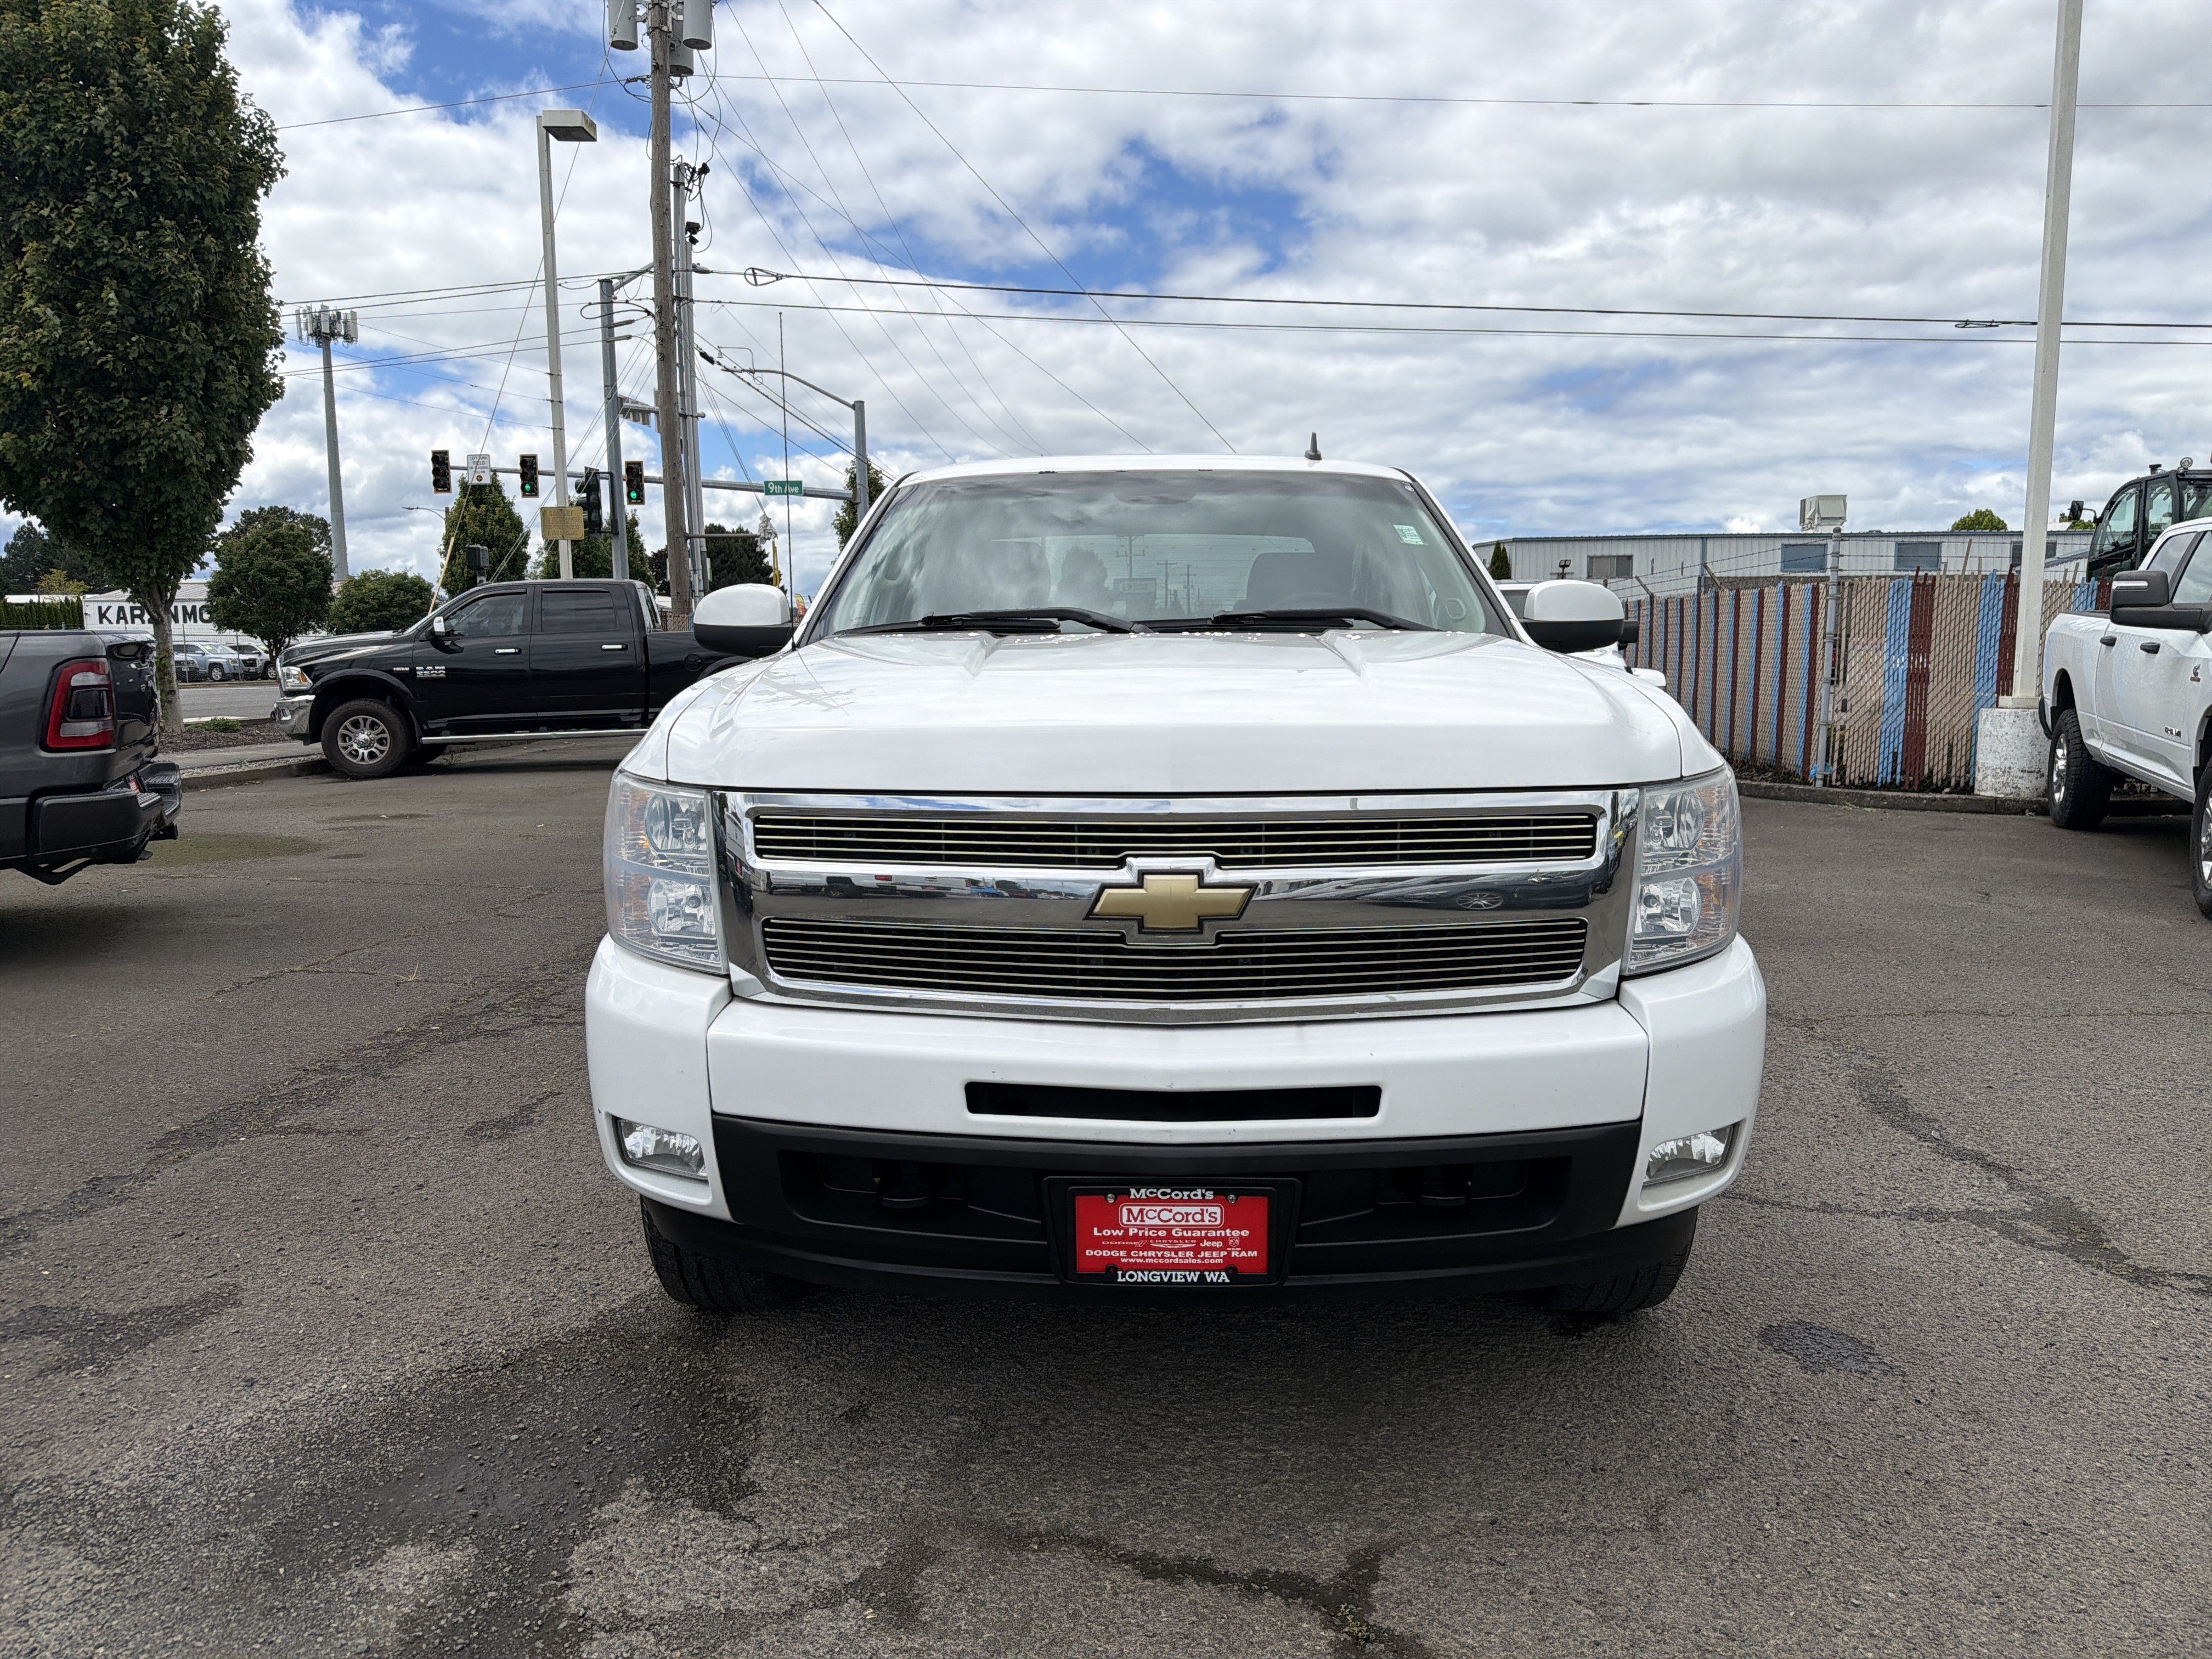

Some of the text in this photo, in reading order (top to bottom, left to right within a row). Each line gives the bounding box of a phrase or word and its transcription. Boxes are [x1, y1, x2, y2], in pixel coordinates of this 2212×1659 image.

[768, 482, 799, 493] 9th Ave
[1130, 1188, 1214, 1200] McCord's
[1126, 1208, 1218, 1223] McCord's
[1093, 1227, 1249, 1237] Low Price Guarantee
[1200, 1239, 1223, 1248] Jeep
[1117, 1271, 1230, 1283] LONGVIEW WA
